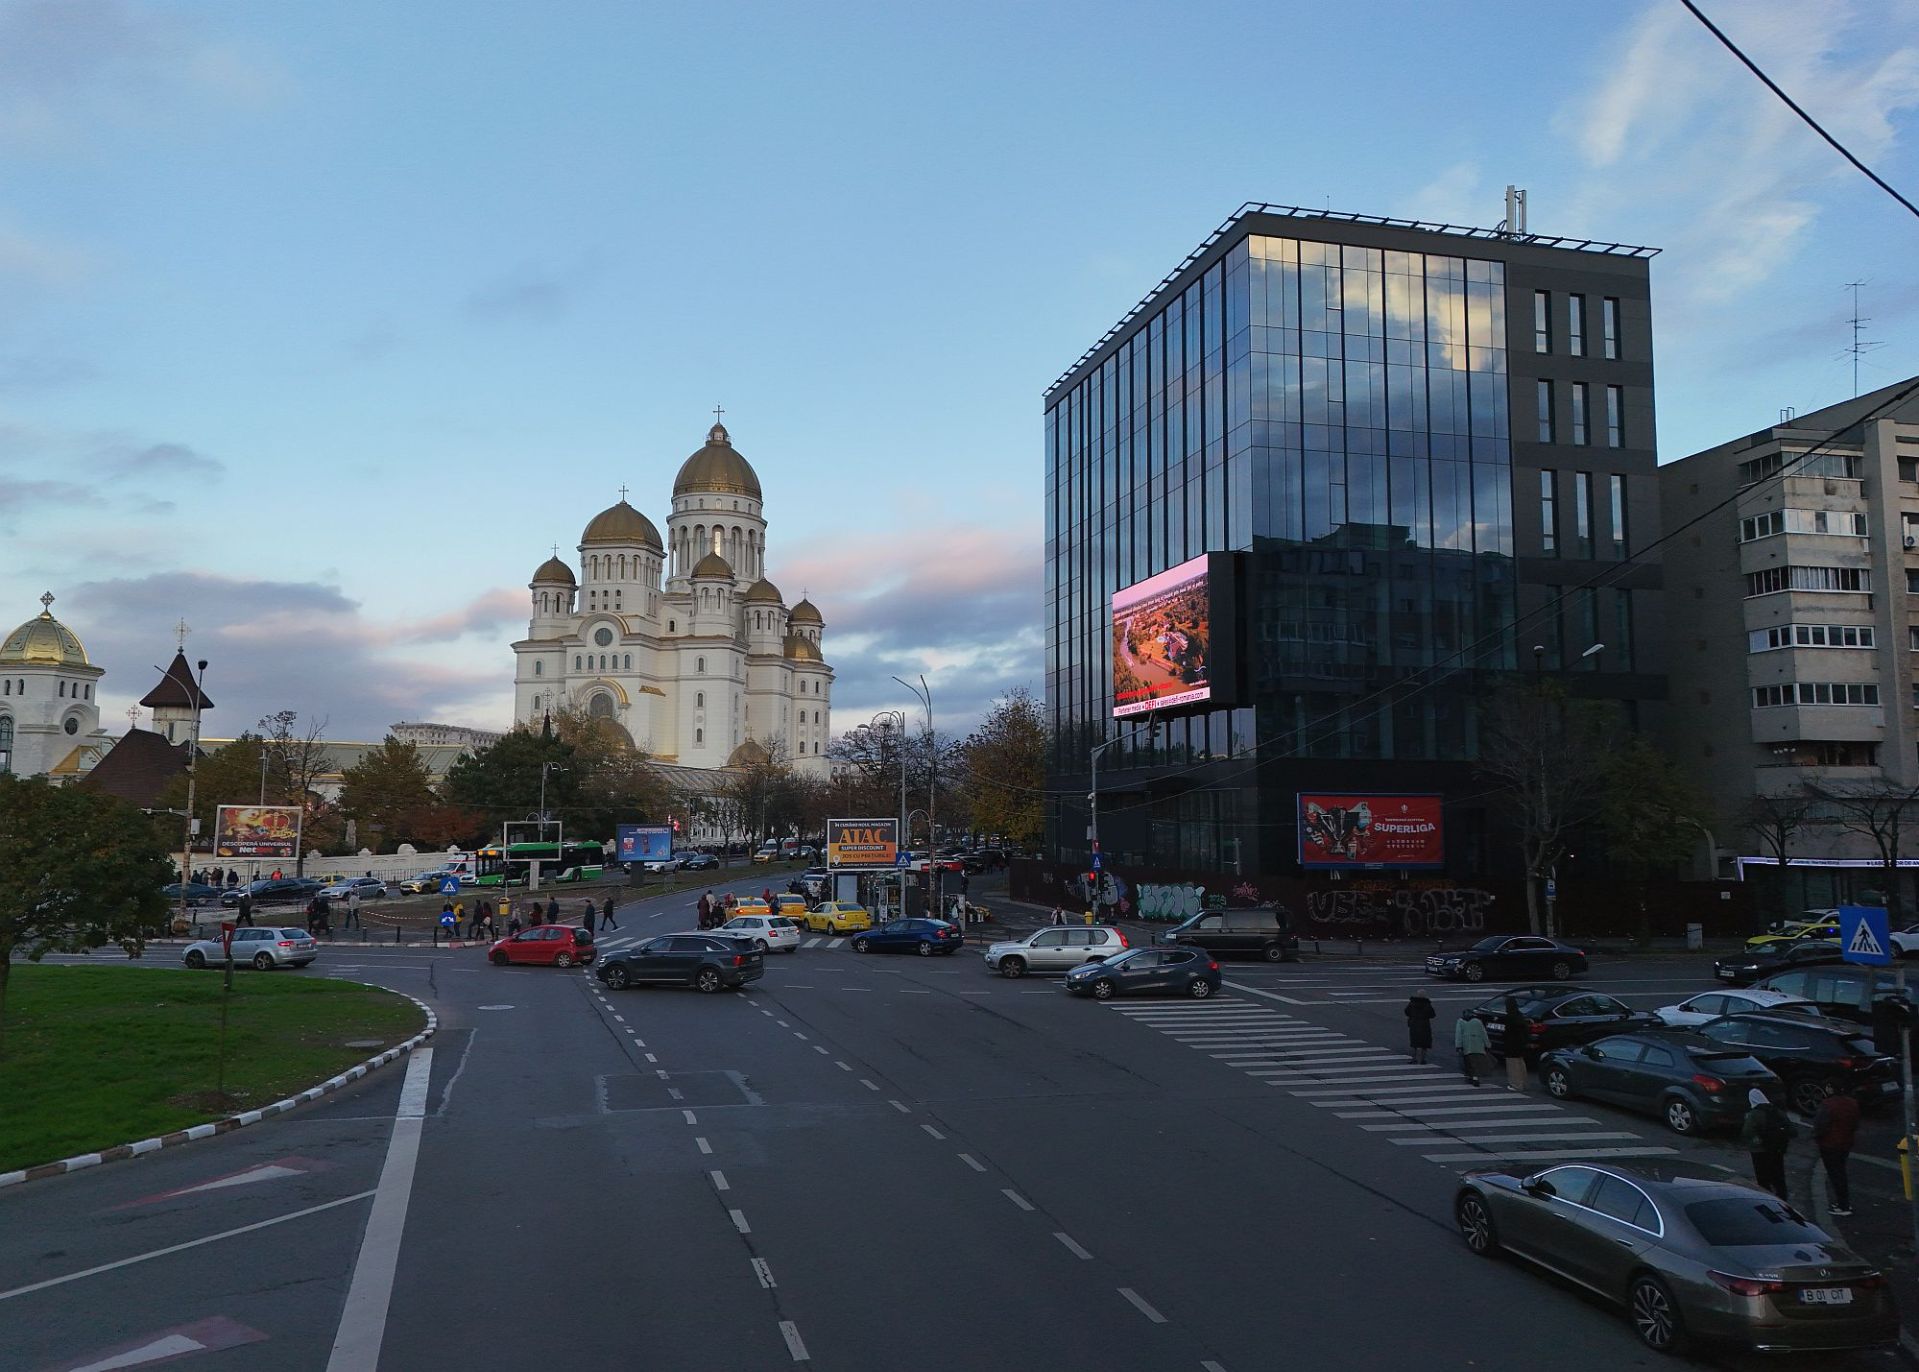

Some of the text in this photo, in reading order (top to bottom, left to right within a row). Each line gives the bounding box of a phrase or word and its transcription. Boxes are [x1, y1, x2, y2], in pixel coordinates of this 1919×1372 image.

[1144, 700, 1157, 711] DEFI
[1374, 822, 1436, 833] SUPERLIGA
[839, 828, 888, 844] ATAC
[1807, 1290, 1814, 1301] B
[1816, 1289, 1826, 1300] 01
